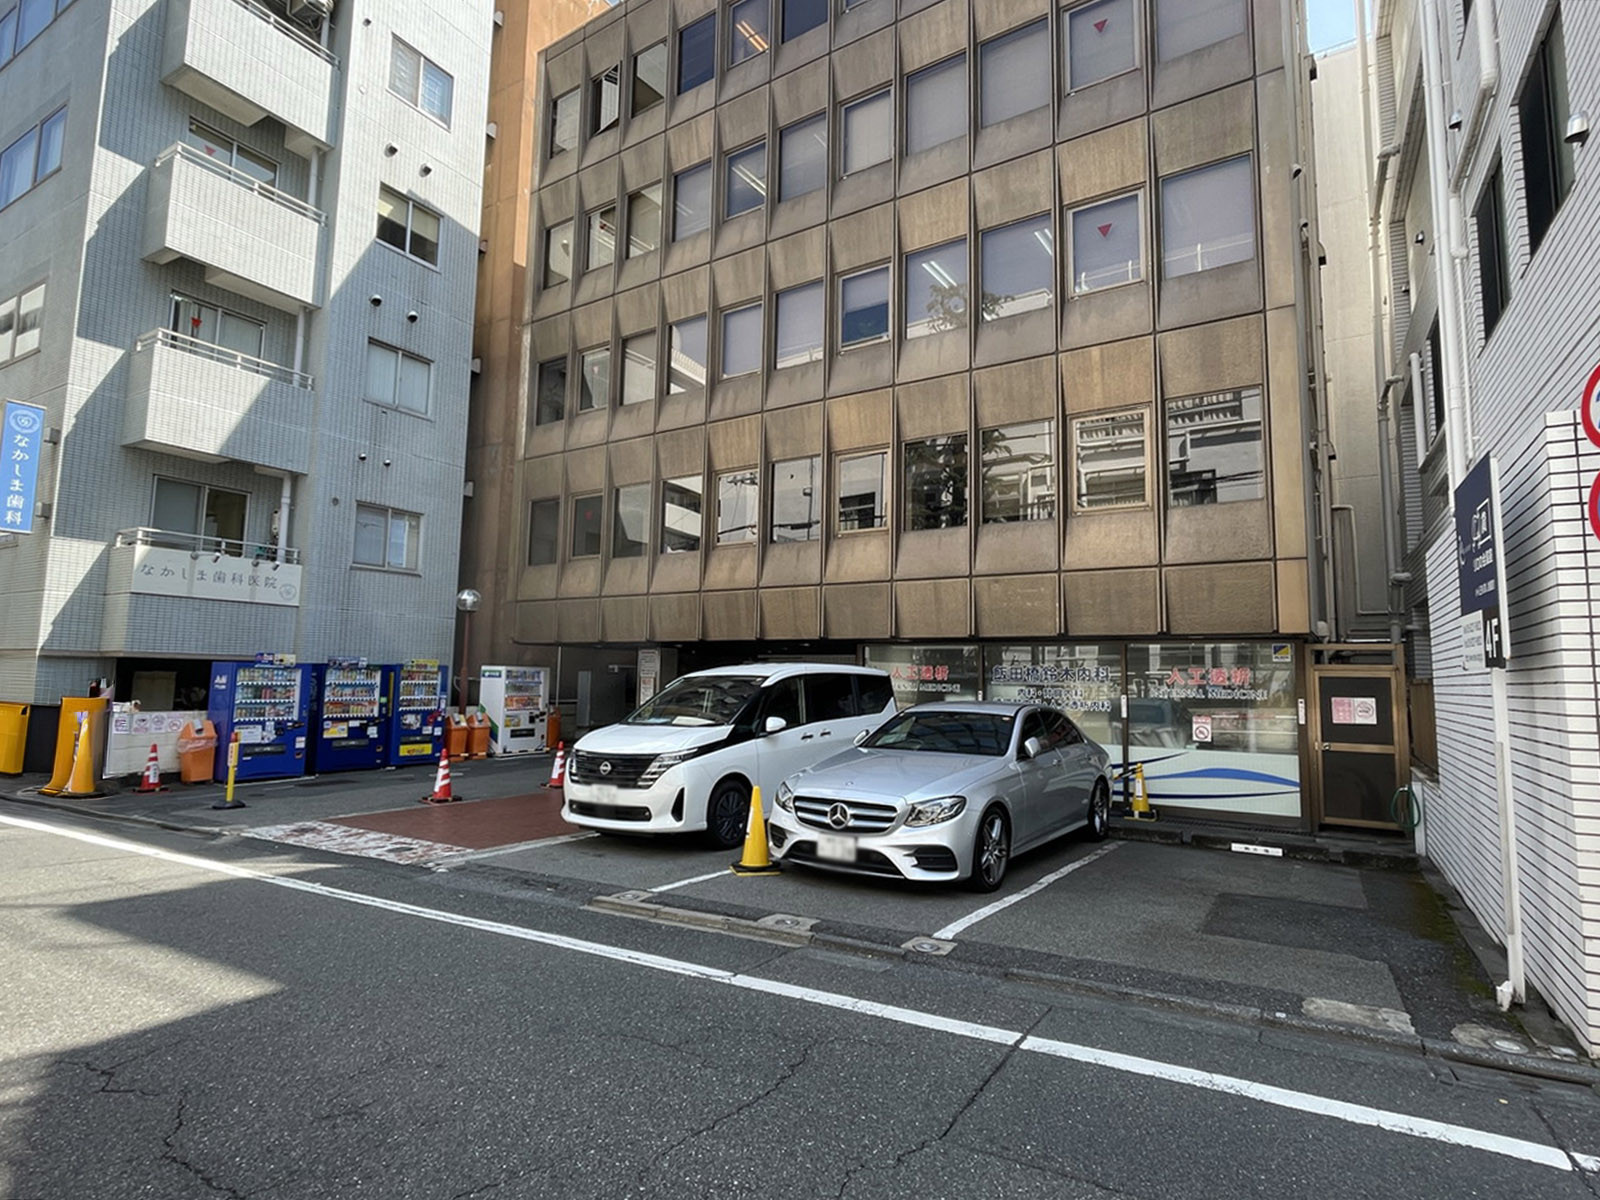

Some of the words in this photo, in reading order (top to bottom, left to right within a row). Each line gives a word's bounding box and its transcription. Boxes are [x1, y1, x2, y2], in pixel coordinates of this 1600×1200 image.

[4, 433, 31, 526] なかしま歯科
[140, 562, 278, 590] なかしま歯科医院
[1485, 617, 1499, 659] 4F
[891, 665, 950, 681] 人工透析
[992, 665, 1111, 682] 飯田橋鈴木内科
[1166, 667, 1252, 686] 人工透析
